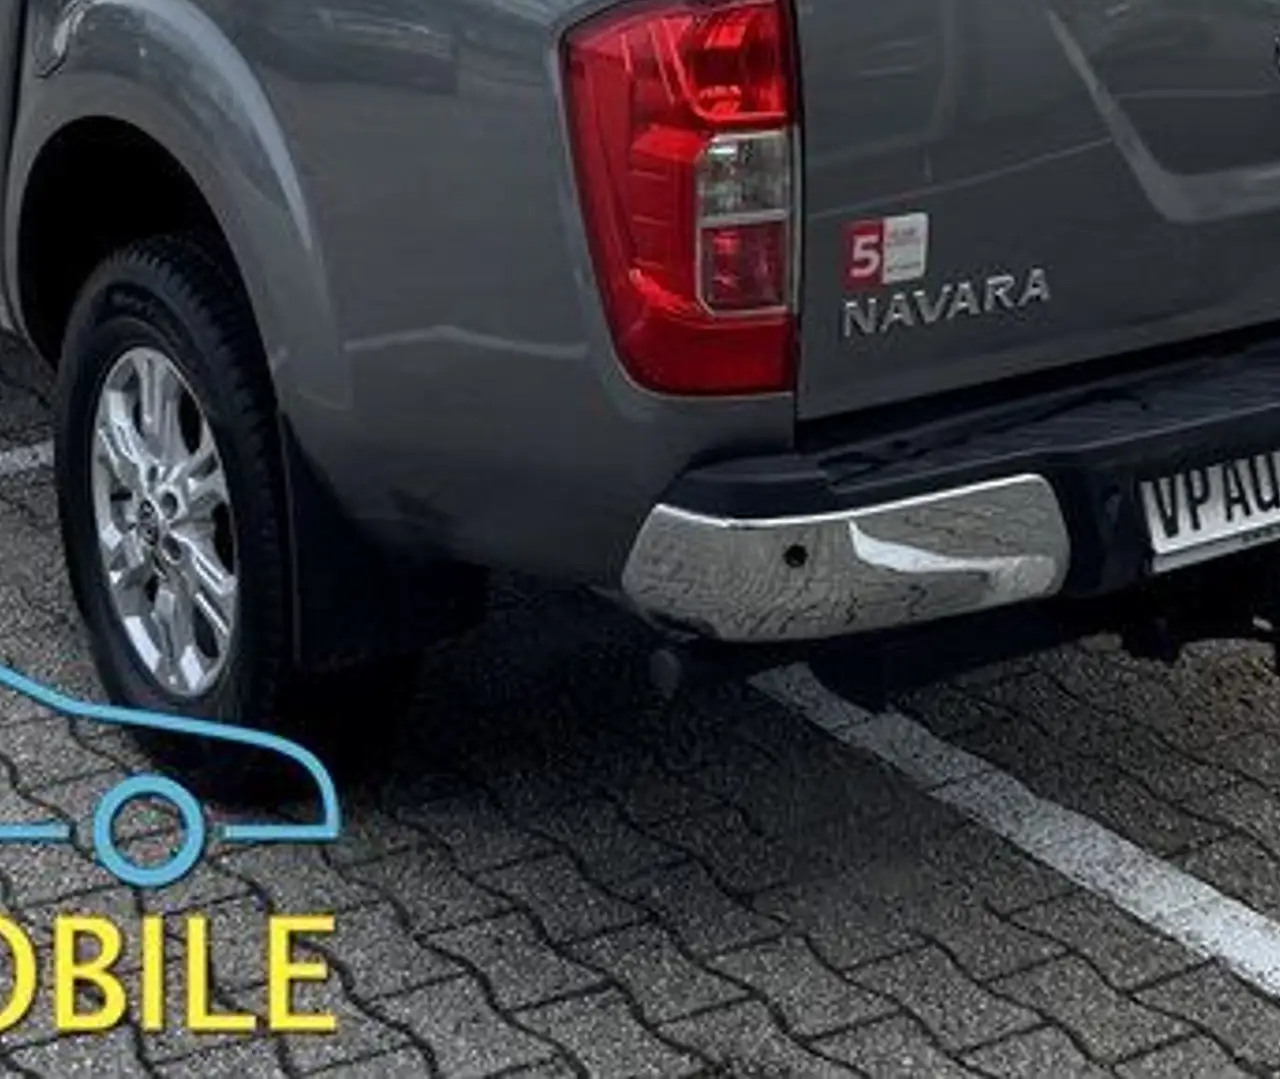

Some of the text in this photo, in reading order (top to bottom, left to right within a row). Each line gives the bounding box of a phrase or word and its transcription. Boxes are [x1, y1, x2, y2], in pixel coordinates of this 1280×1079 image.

[849, 234, 880, 278] 5
[842, 267, 1052, 338] NAVARA
[1150, 466, 1211, 541] VP
